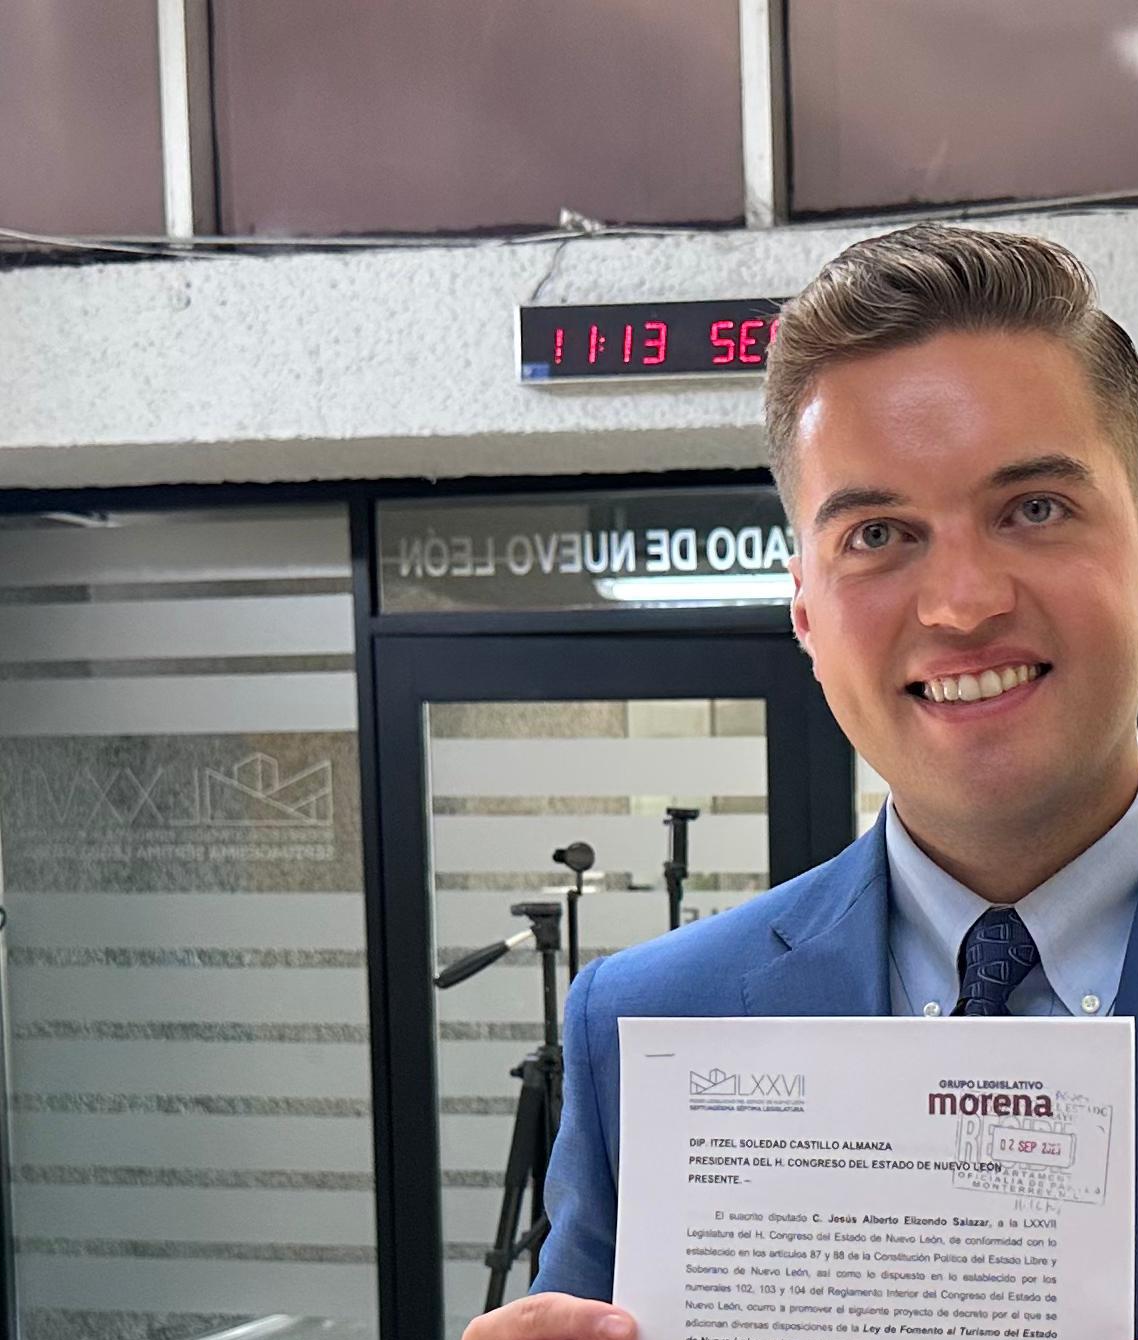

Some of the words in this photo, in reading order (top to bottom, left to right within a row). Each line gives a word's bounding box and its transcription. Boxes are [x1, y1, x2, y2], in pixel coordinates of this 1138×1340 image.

[554, 320, 668, 366] 11:13
[738, 1073, 806, 1098] LXXVII
[939, 1080, 976, 1089] GRUPO
[977, 1080, 1044, 1090] LEGISLATIVO
[928, 1092, 1054, 1117] morena
[711, 1139, 738, 1148] ITZEL
[740, 1139, 788, 1148] SOLEDAD
[790, 1140, 841, 1150] CASTILLO
[842, 1141, 894, 1151] ALMANZA
[689, 1156, 751, 1166] PRESIDENTA
[753, 1158, 773, 1167] DEL
[788, 1158, 847, 1168] CONGRESO
[849, 1160, 870, 1168] DEL
[872, 1160, 915, 1169] ESTADO
[917, 1161, 932, 1170] DE
[933, 1160, 971, 1172] NUEVO
[973, 1159, 1003, 1173] LEÓN
[828, 1214, 858, 1223] Jesús
[863, 1215, 900, 1224] Alberto
[904, 1216, 948, 1226] Elizondo
[863, 1324, 882, 1335] Ley
[900, 1325, 944, 1335] Fomento
[960, 1327, 1001, 1336] Turismo
